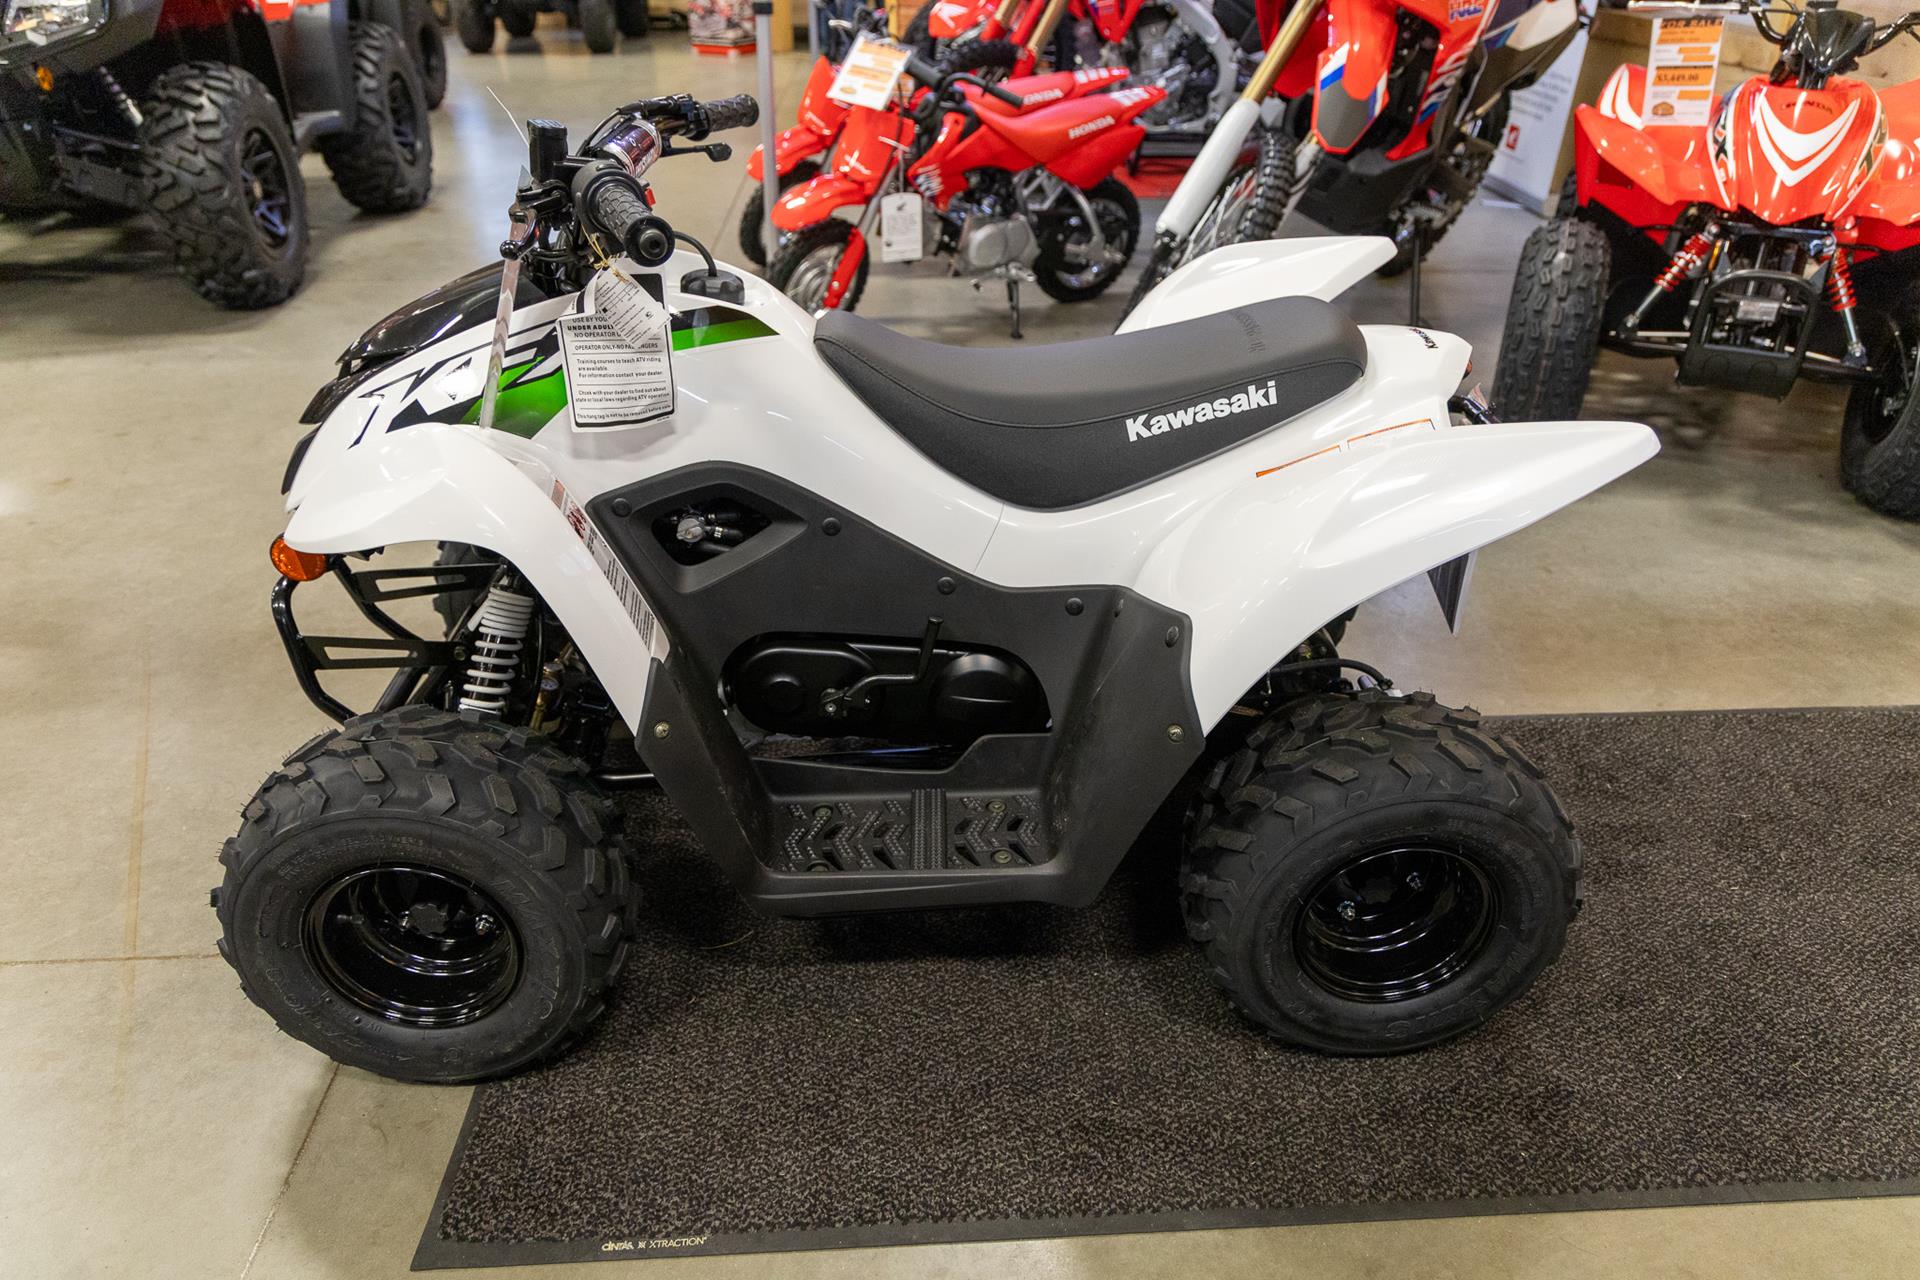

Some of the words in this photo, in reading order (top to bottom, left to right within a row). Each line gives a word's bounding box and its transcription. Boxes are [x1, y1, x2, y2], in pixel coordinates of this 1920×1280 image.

[1023, 87, 1064, 106] ONDA
[1068, 114, 1116, 141] HONDA
[1125, 380, 1278, 442] Kawasaki
